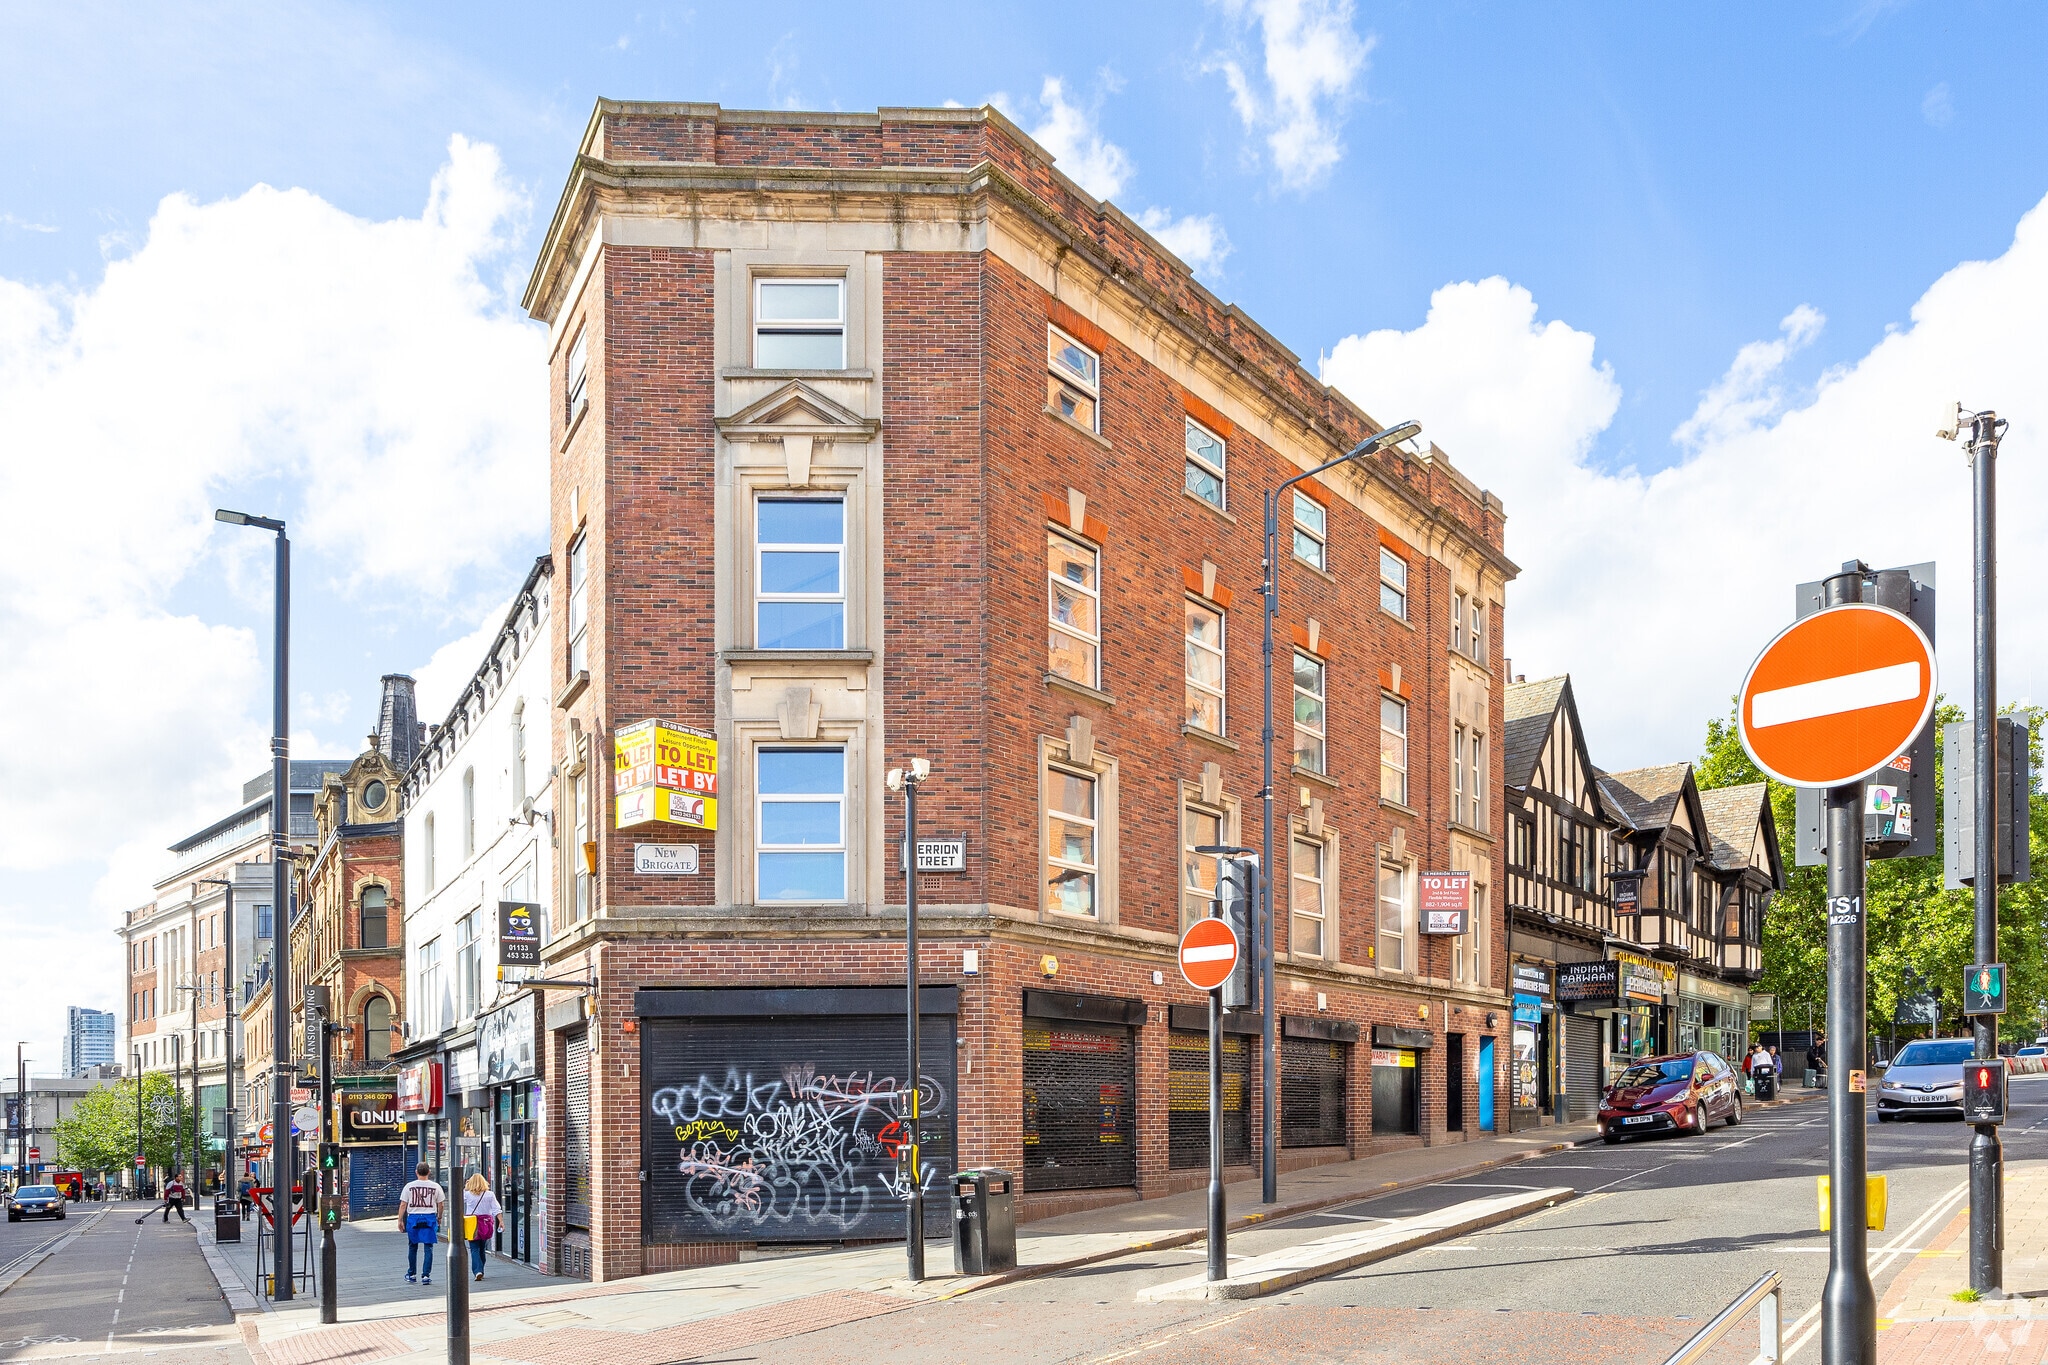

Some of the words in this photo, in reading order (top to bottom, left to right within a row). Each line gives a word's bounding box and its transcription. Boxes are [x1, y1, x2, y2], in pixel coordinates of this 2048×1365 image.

[666, 731, 693, 741] Prominent
[662, 738, 682, 747] Leisure
[682, 741, 711, 754] Opportunity
[617, 751, 631, 768] TO
[633, 743, 652, 764] LET
[658, 744, 681, 763] TO
[686, 750, 715, 771] LET
[616, 769, 633, 793] LET
[635, 763, 652, 787] BY
[657, 766, 689, 787] LET
[693, 771, 715, 791] BY
[917, 844, 959, 855] ERRION
[918, 856, 956, 866] TREET
[1423, 878, 1441, 889] TO
[1443, 878, 1468, 889] LET
[1828, 896, 1860, 915] TS1
[1830, 914, 1857, 925] M226
[1570, 965, 1606, 974] INDIAN
[1561, 973, 1615, 983] PAKWAAN
[307, 989, 316, 1021] LIVING
[1931, 1094, 1945, 1102] RVP
[409, 1186, 437, 1208] DIRT
